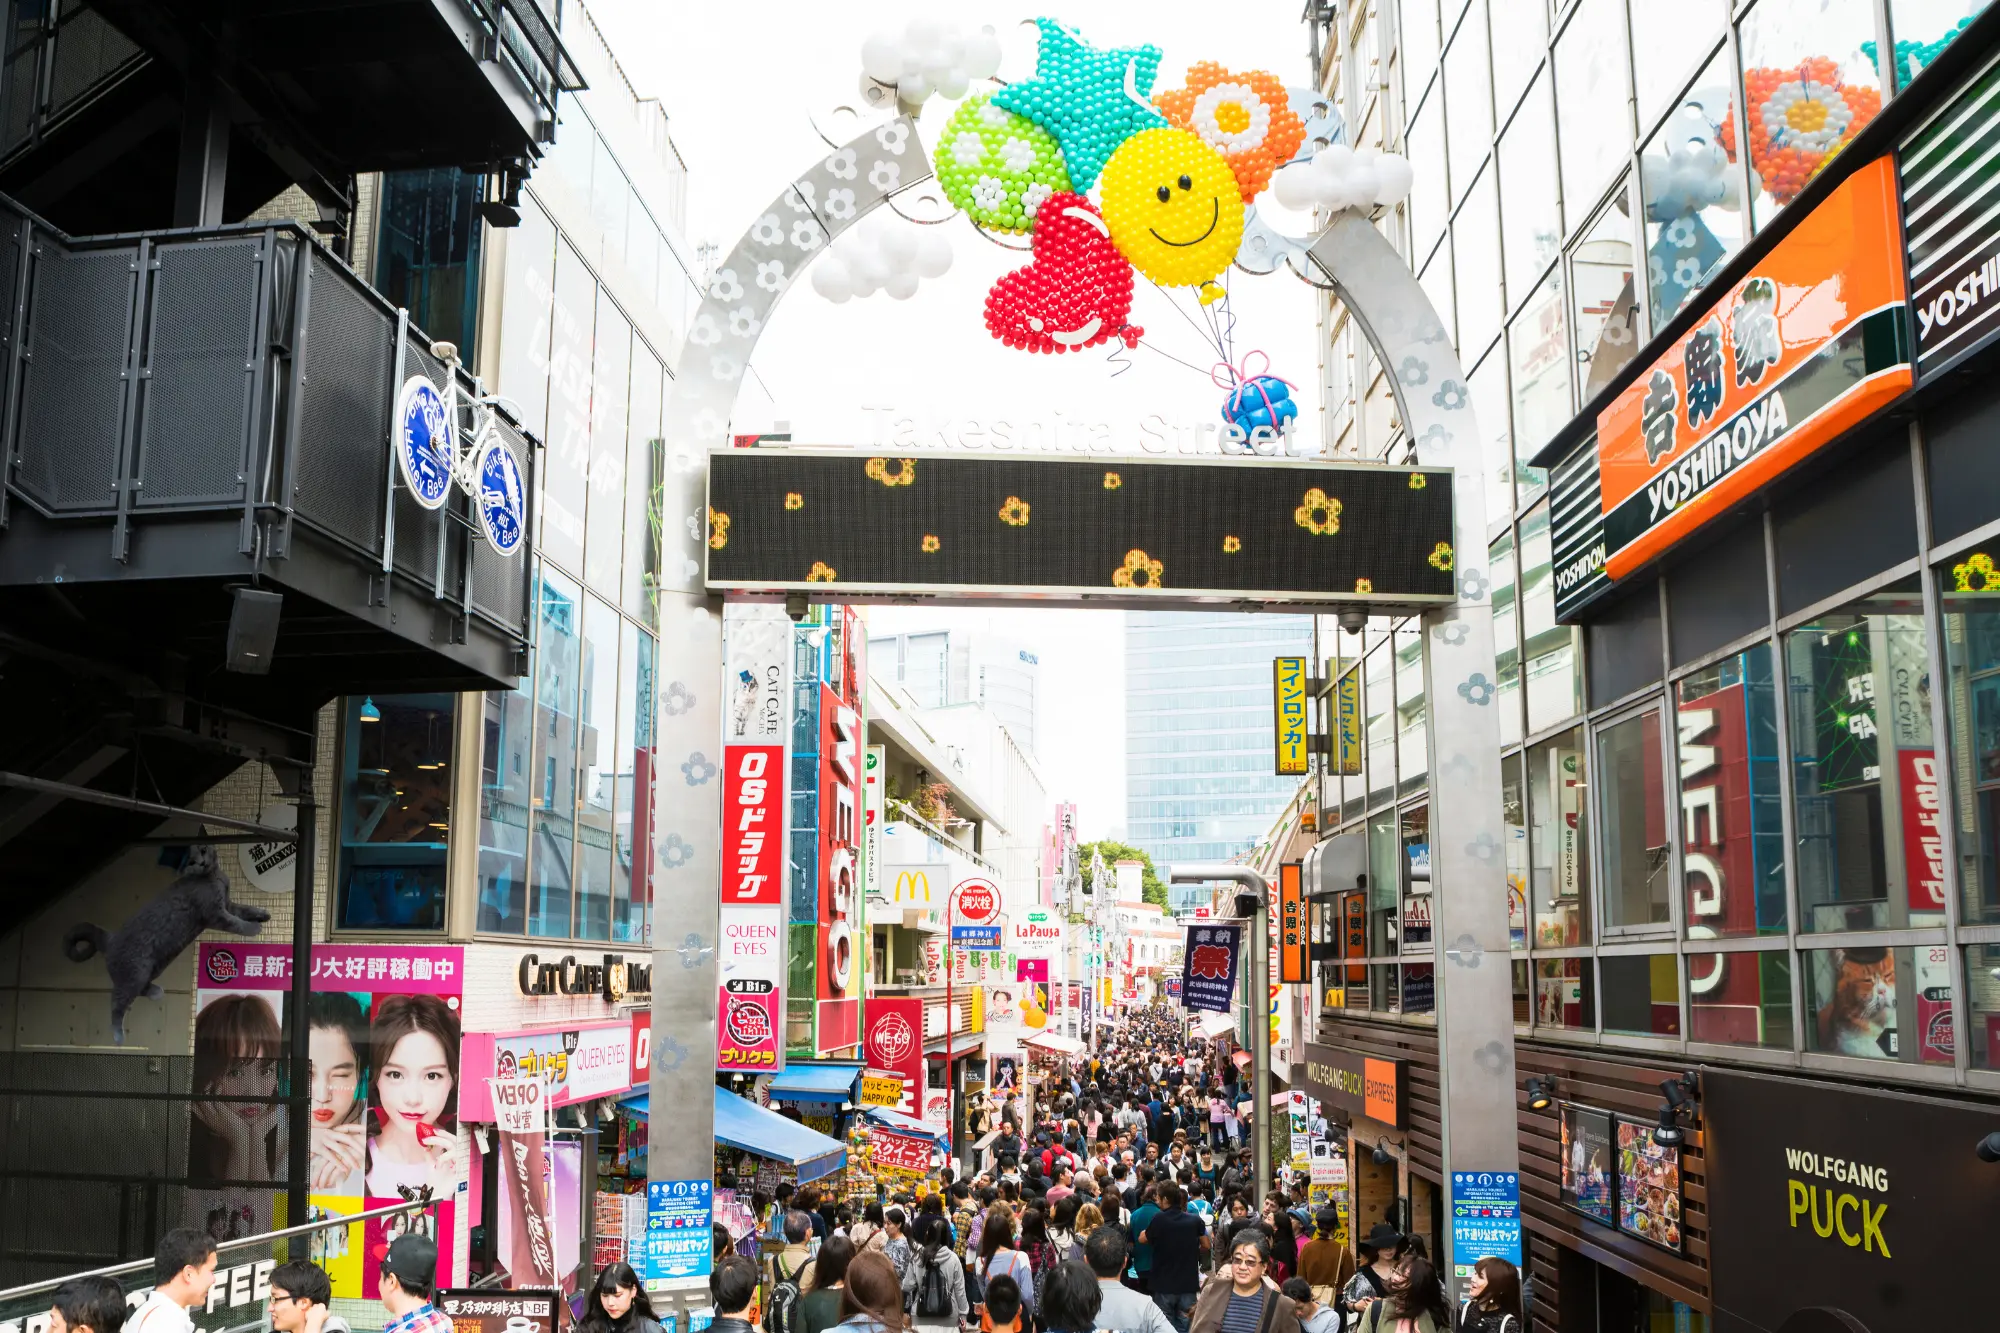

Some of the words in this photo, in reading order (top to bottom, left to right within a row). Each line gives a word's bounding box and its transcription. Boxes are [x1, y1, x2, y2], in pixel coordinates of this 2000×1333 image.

[1640, 276, 1784, 468] 吉野家
[1139, 412, 1301, 458] Street
[1647, 390, 1790, 525] YOSHINOYA
[1281, 659, 1304, 760] コインロッカー
[1281, 761, 1306, 772] 3F
[737, 752, 769, 899] OSドラッグ
[829, 705, 858, 990] WEGO
[961, 895, 991, 910] 消火栓
[726, 924, 776, 938] QUEEN
[1029, 924, 1060, 939] Pausa
[1285, 900, 1297, 946] 吉野家
[734, 942, 767, 955] EYES
[1190, 944, 1232, 980] 祭
[745, 981, 767, 992] B1F
[576, 1047, 606, 1071] QUEEN
[607, 1043, 626, 1066] EYES
[863, 1080, 903, 1092] ハッピーワン
[1306, 1060, 1343, 1092] WOLFGANG
[1342, 1071, 1363, 1097] PUCK
[1366, 1079, 1395, 1105] EXPRESS
[861, 1093, 885, 1103] HAPPY
[870, 1153, 929, 1170] SQUEEZE
[871, 1141, 931, 1163] スクイーズ
[1785, 1147, 1889, 1193] WOLFGANG
[1788, 1178, 1892, 1259] PUCK
[1455, 1227, 1519, 1242] 竹下通り公式マップ
[648, 1238, 710, 1254] 竹下通り公式マップ
[443, 1300, 523, 1317] 星乃珈琲店
